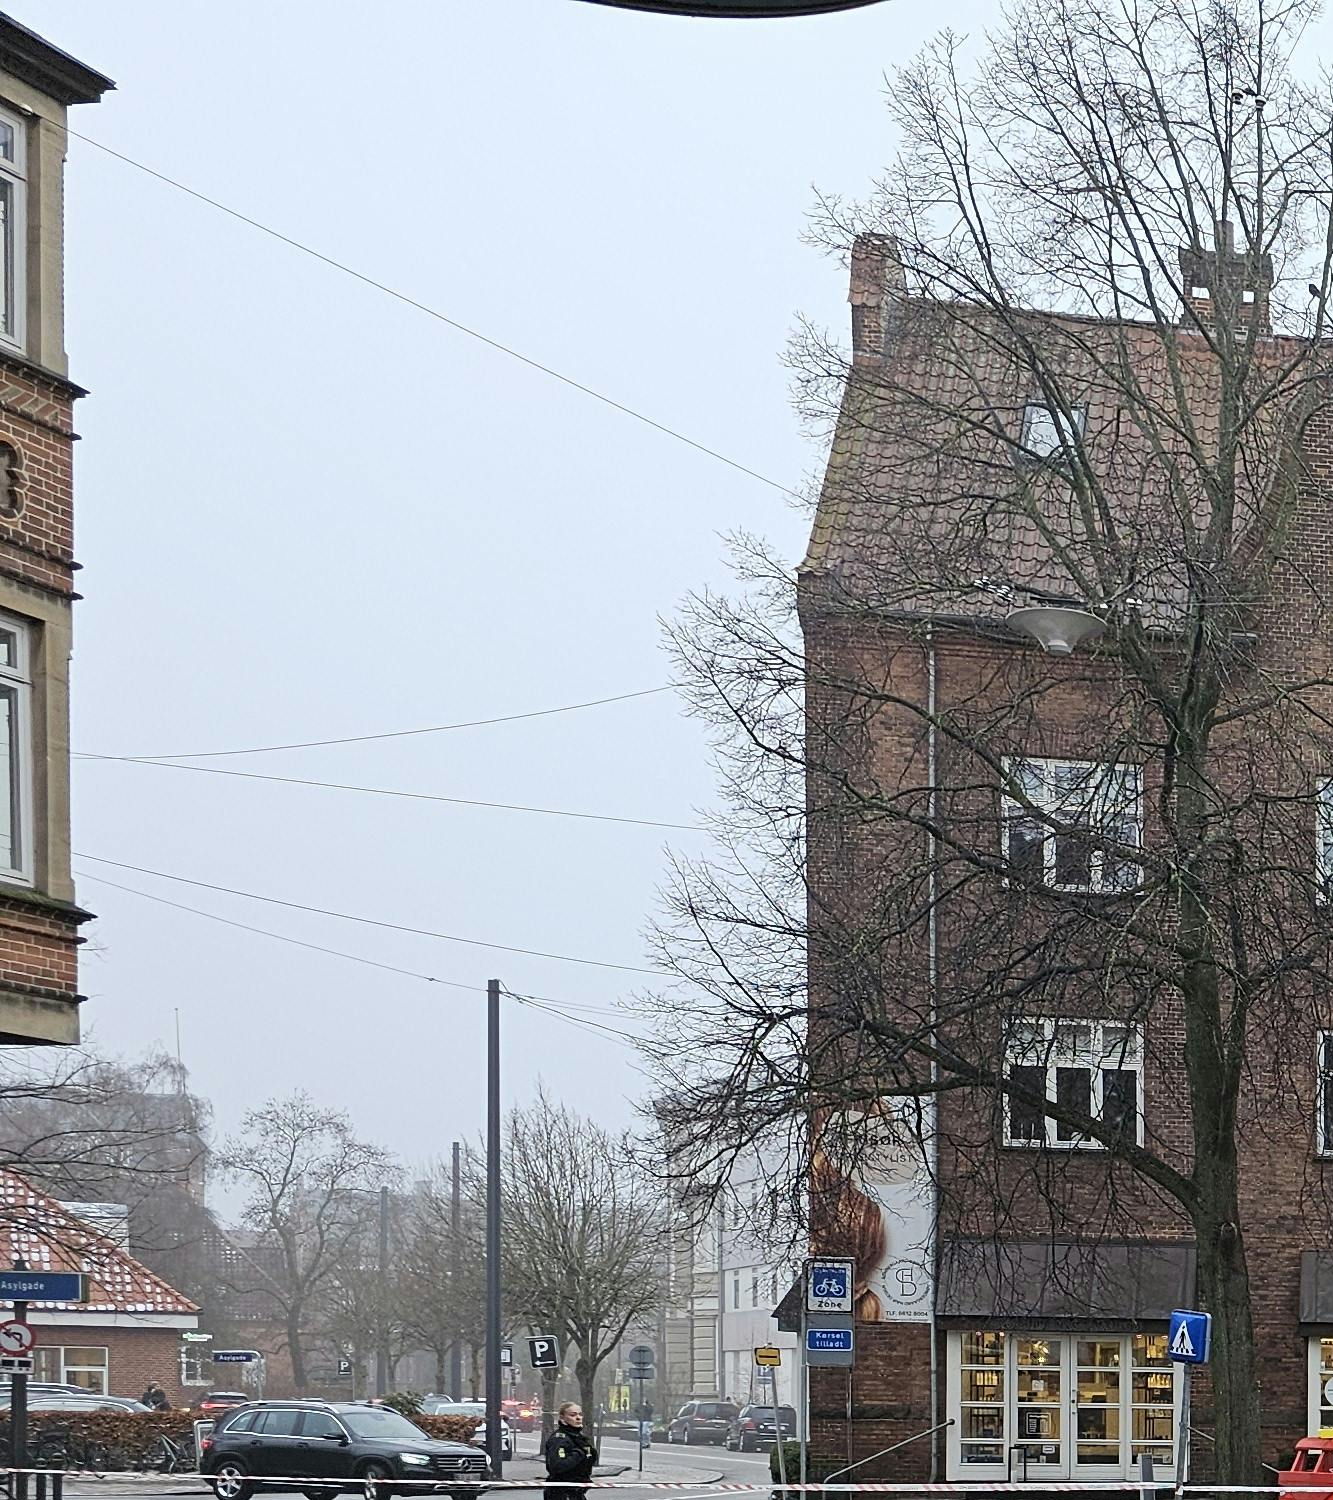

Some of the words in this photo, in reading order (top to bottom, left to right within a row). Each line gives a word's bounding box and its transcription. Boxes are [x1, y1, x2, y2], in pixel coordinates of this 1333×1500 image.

[1, 1281, 45, 1292] Asylgade
[817, 1300, 843, 1309] Zone
[815, 1340, 844, 1348] tilladt
